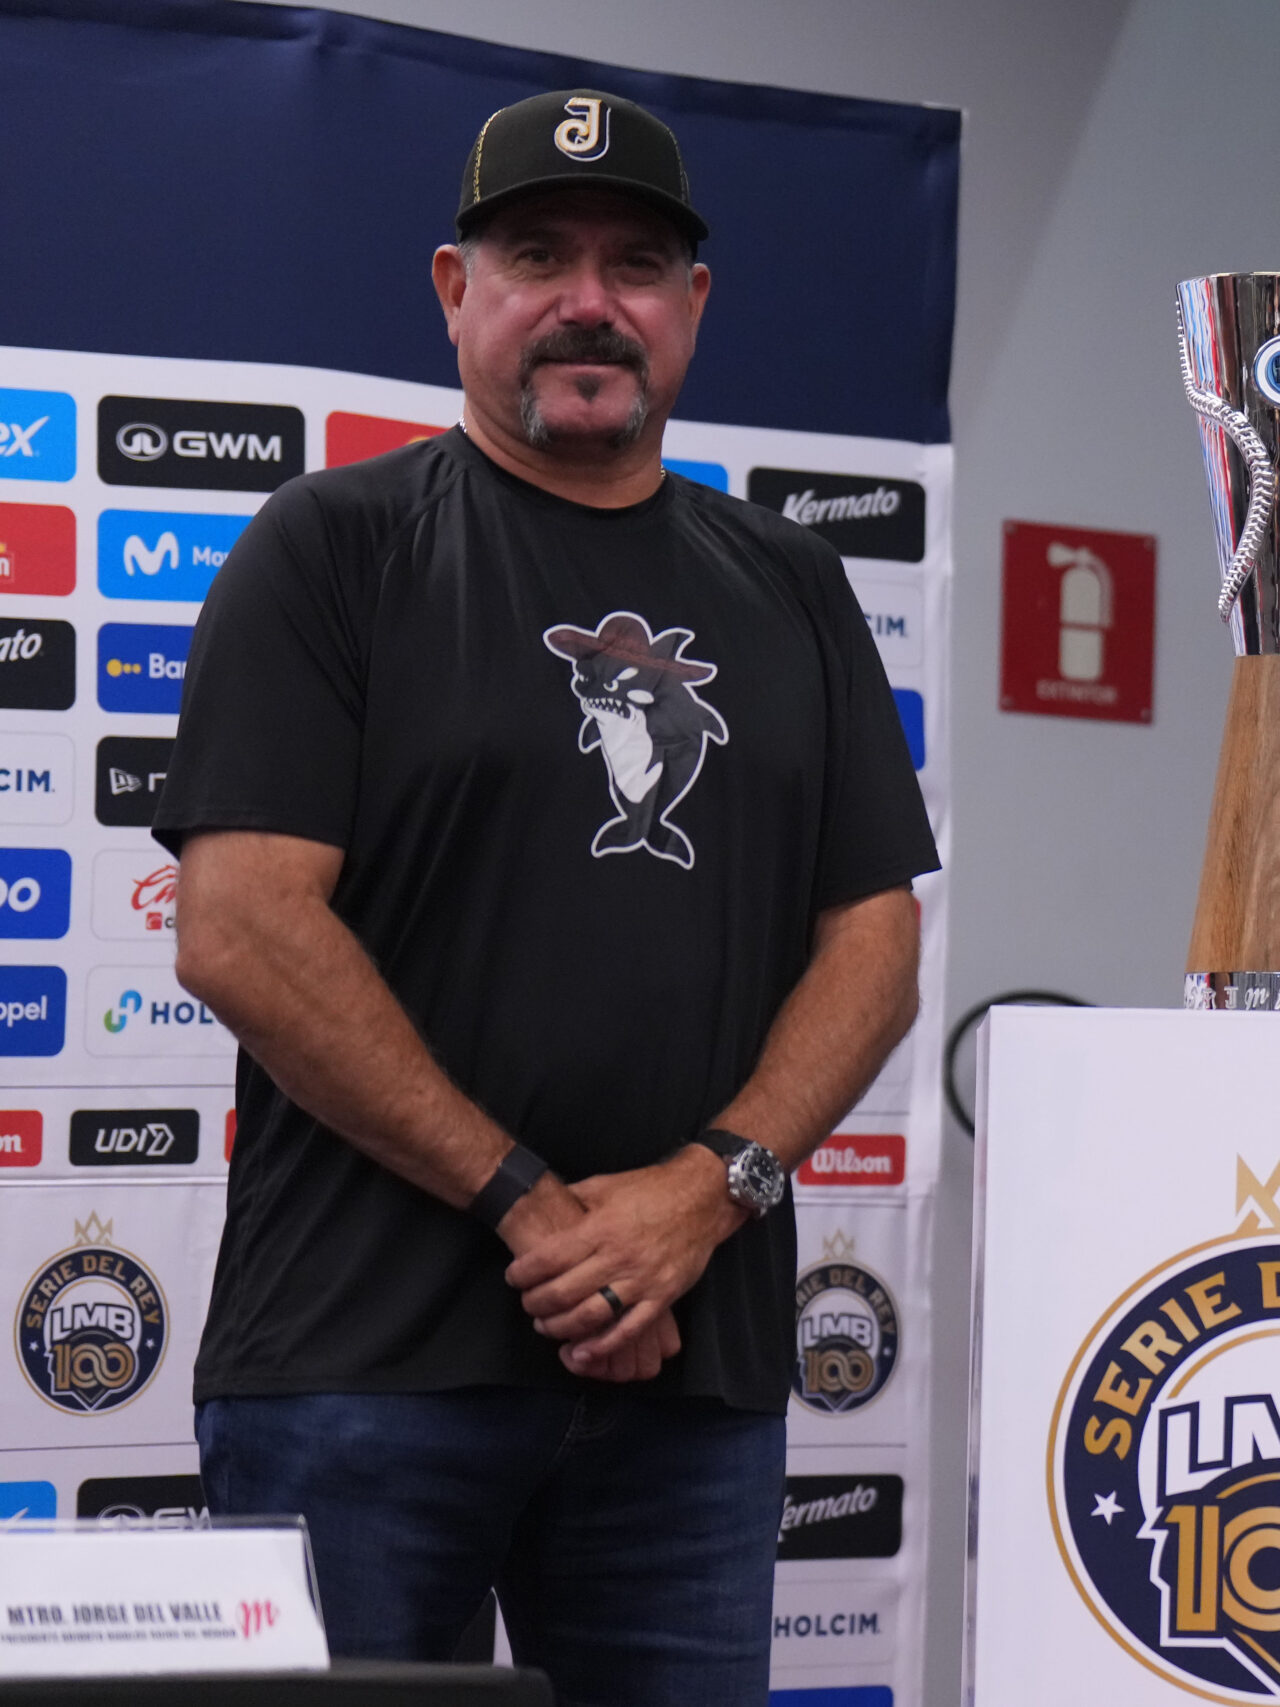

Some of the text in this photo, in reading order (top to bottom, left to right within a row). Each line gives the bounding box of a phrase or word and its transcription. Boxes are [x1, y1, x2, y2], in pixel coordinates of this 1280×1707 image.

[173, 430, 282, 463] GWM
[811, 1147, 892, 1174] Wilson
[26, 1255, 160, 1329] SERIE DEL REY
[52, 1303, 135, 1340] LMB
[803, 1312, 873, 1348] LMB
[53, 1343, 135, 1389] 100
[806, 1350, 874, 1392] 100
[1083, 1271, 1243, 1461] SERIE
[777, 1484, 878, 1542] ermato
[773, 1613, 878, 1638] HOLCIM
